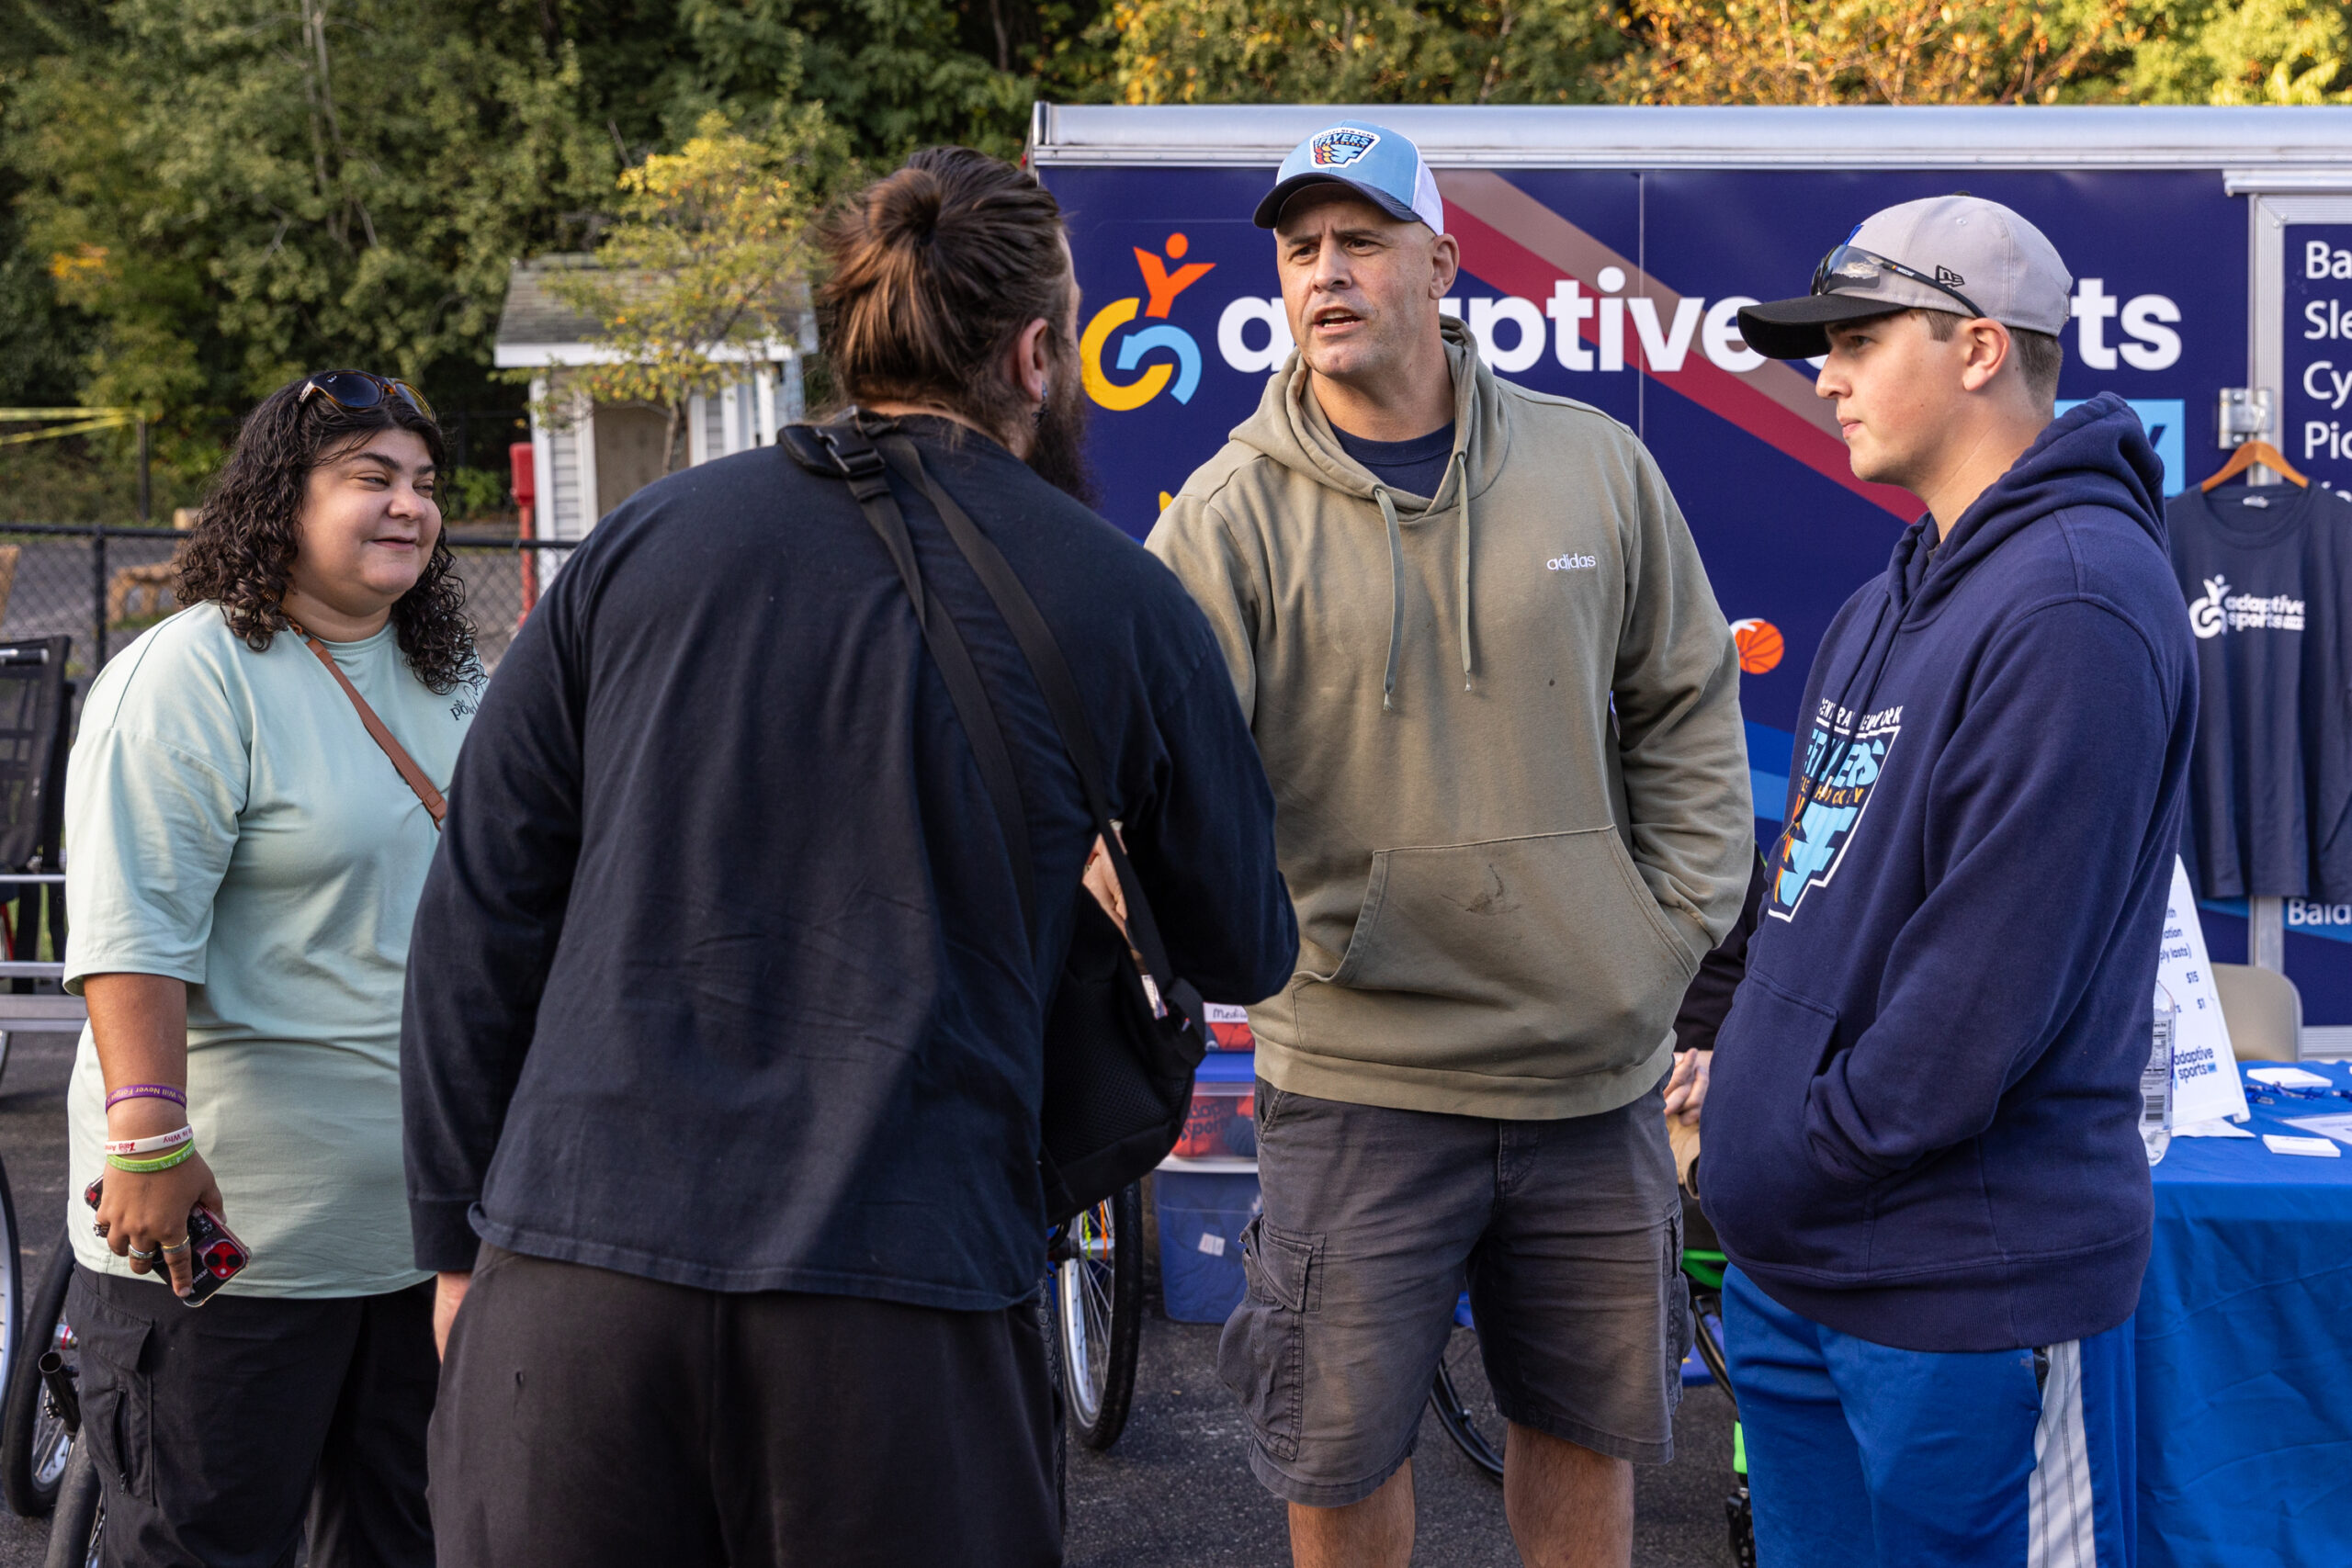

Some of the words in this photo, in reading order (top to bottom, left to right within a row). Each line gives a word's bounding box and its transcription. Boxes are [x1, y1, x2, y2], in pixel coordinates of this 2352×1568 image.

[1317, 133, 1370, 146] FLYERS
[1217, 265, 1770, 373] aptive
[1546, 552, 1596, 570] adidas
[2224, 592, 2305, 615] adaptive
[2227, 612, 2283, 632] sports
[2170, 942, 2192, 959] lasts)
[2186, 971, 2199, 984] $15
[2174, 1045, 2214, 1066] adaptive
[2177, 1063, 2208, 1084] sports
[135, 1087, 161, 1095] Never
[163, 1134, 182, 1145] Why
